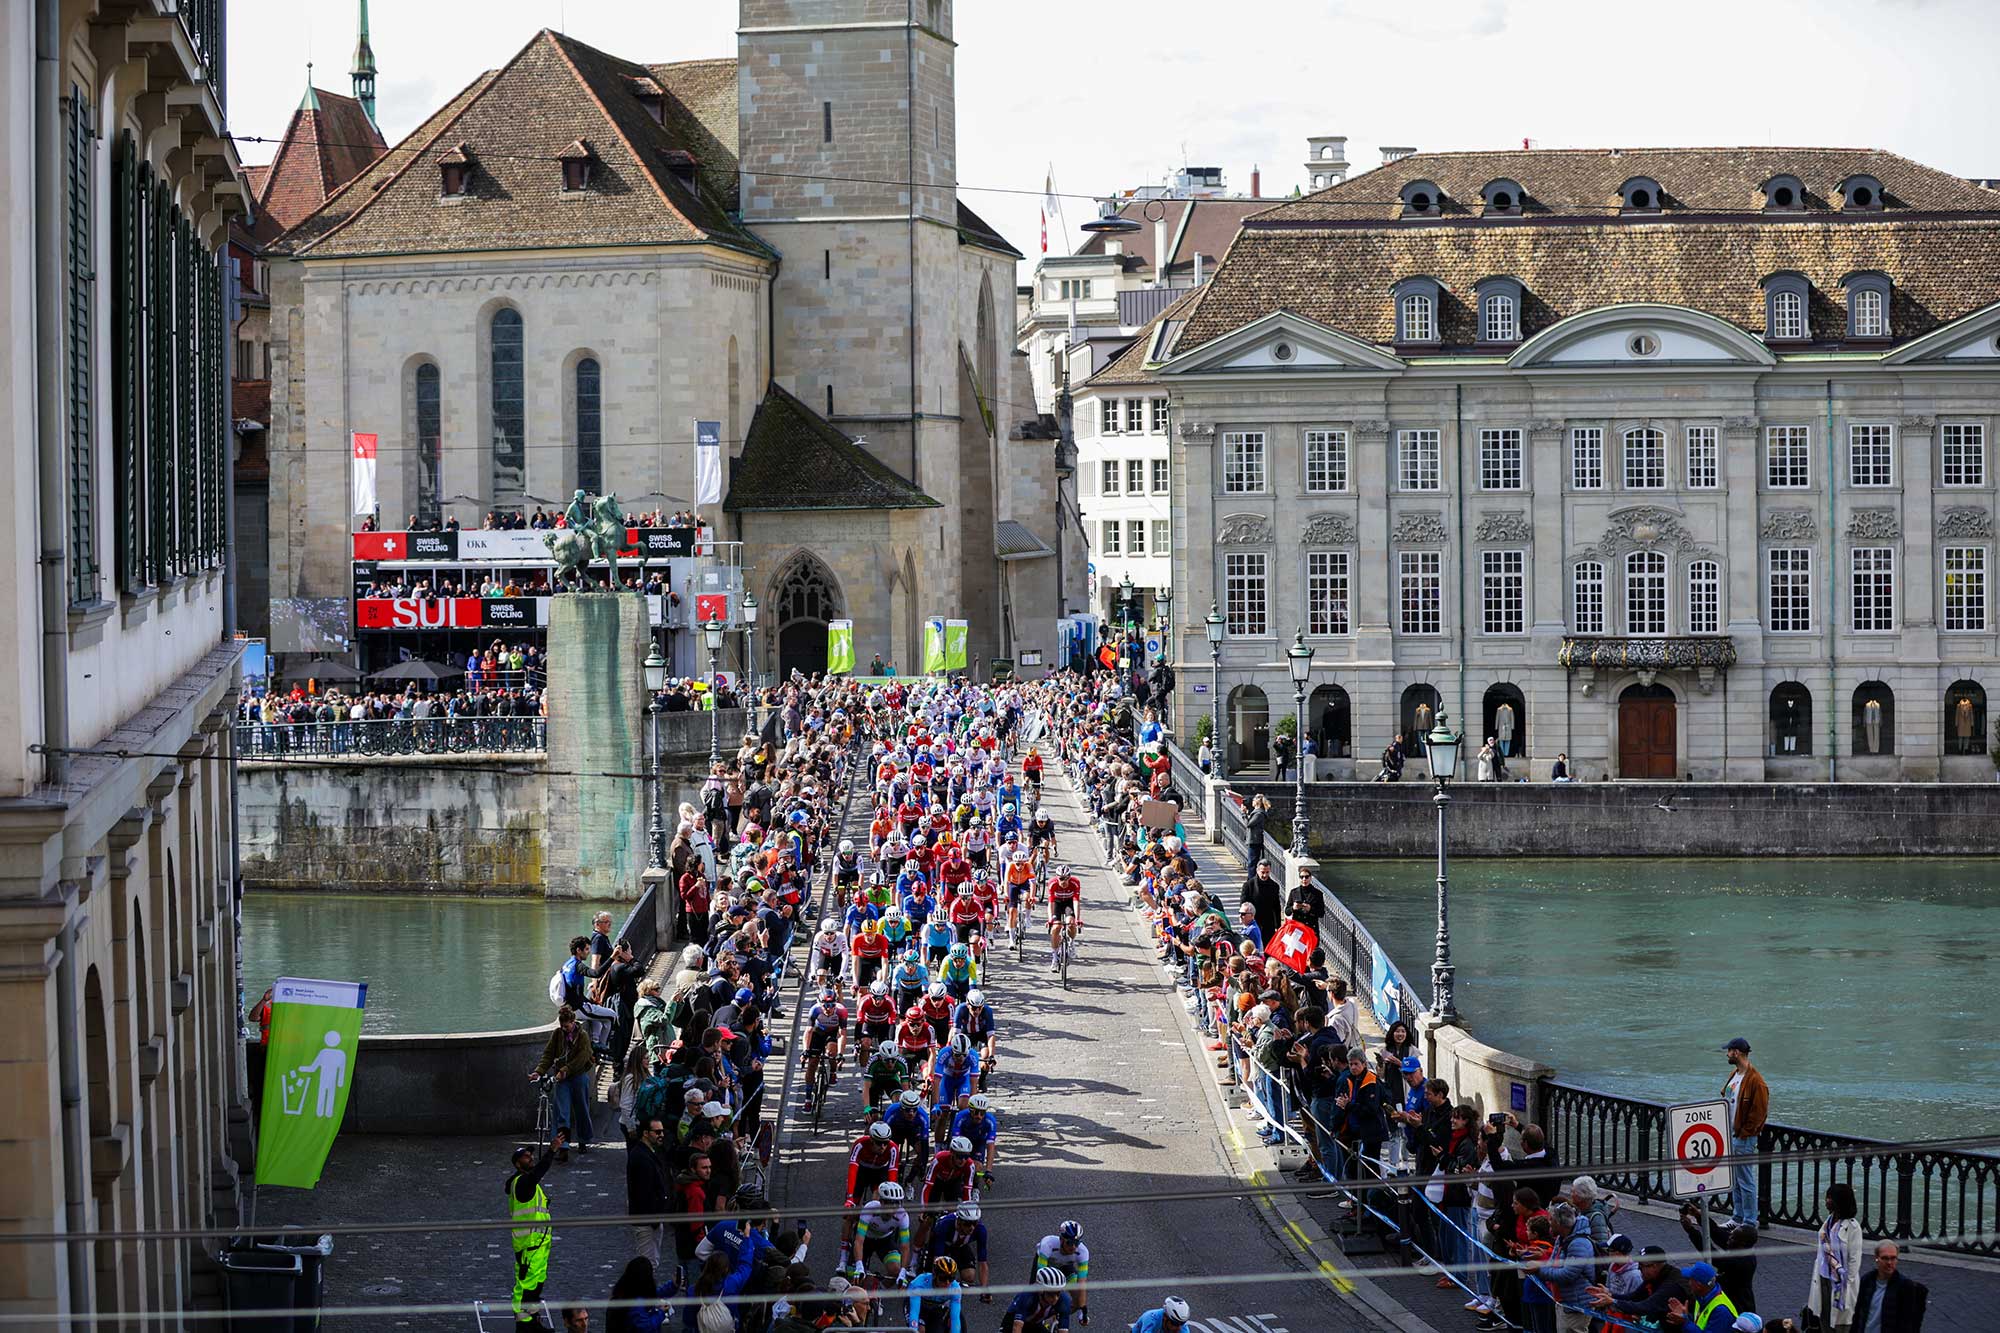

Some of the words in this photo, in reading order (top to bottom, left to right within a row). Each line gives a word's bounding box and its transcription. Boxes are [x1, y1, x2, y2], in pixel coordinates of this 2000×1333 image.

[648, 534, 673, 542] SWISS
[416, 544, 448, 552] CYCLING
[648, 541, 682, 549] CYCLING
[490, 604, 515, 612] SWISS
[393, 598, 456, 627] SUI
[490, 611, 523, 619] CYCLING
[1685, 1110, 1713, 1123] ZONE
[1691, 1138, 1711, 1160] 30
